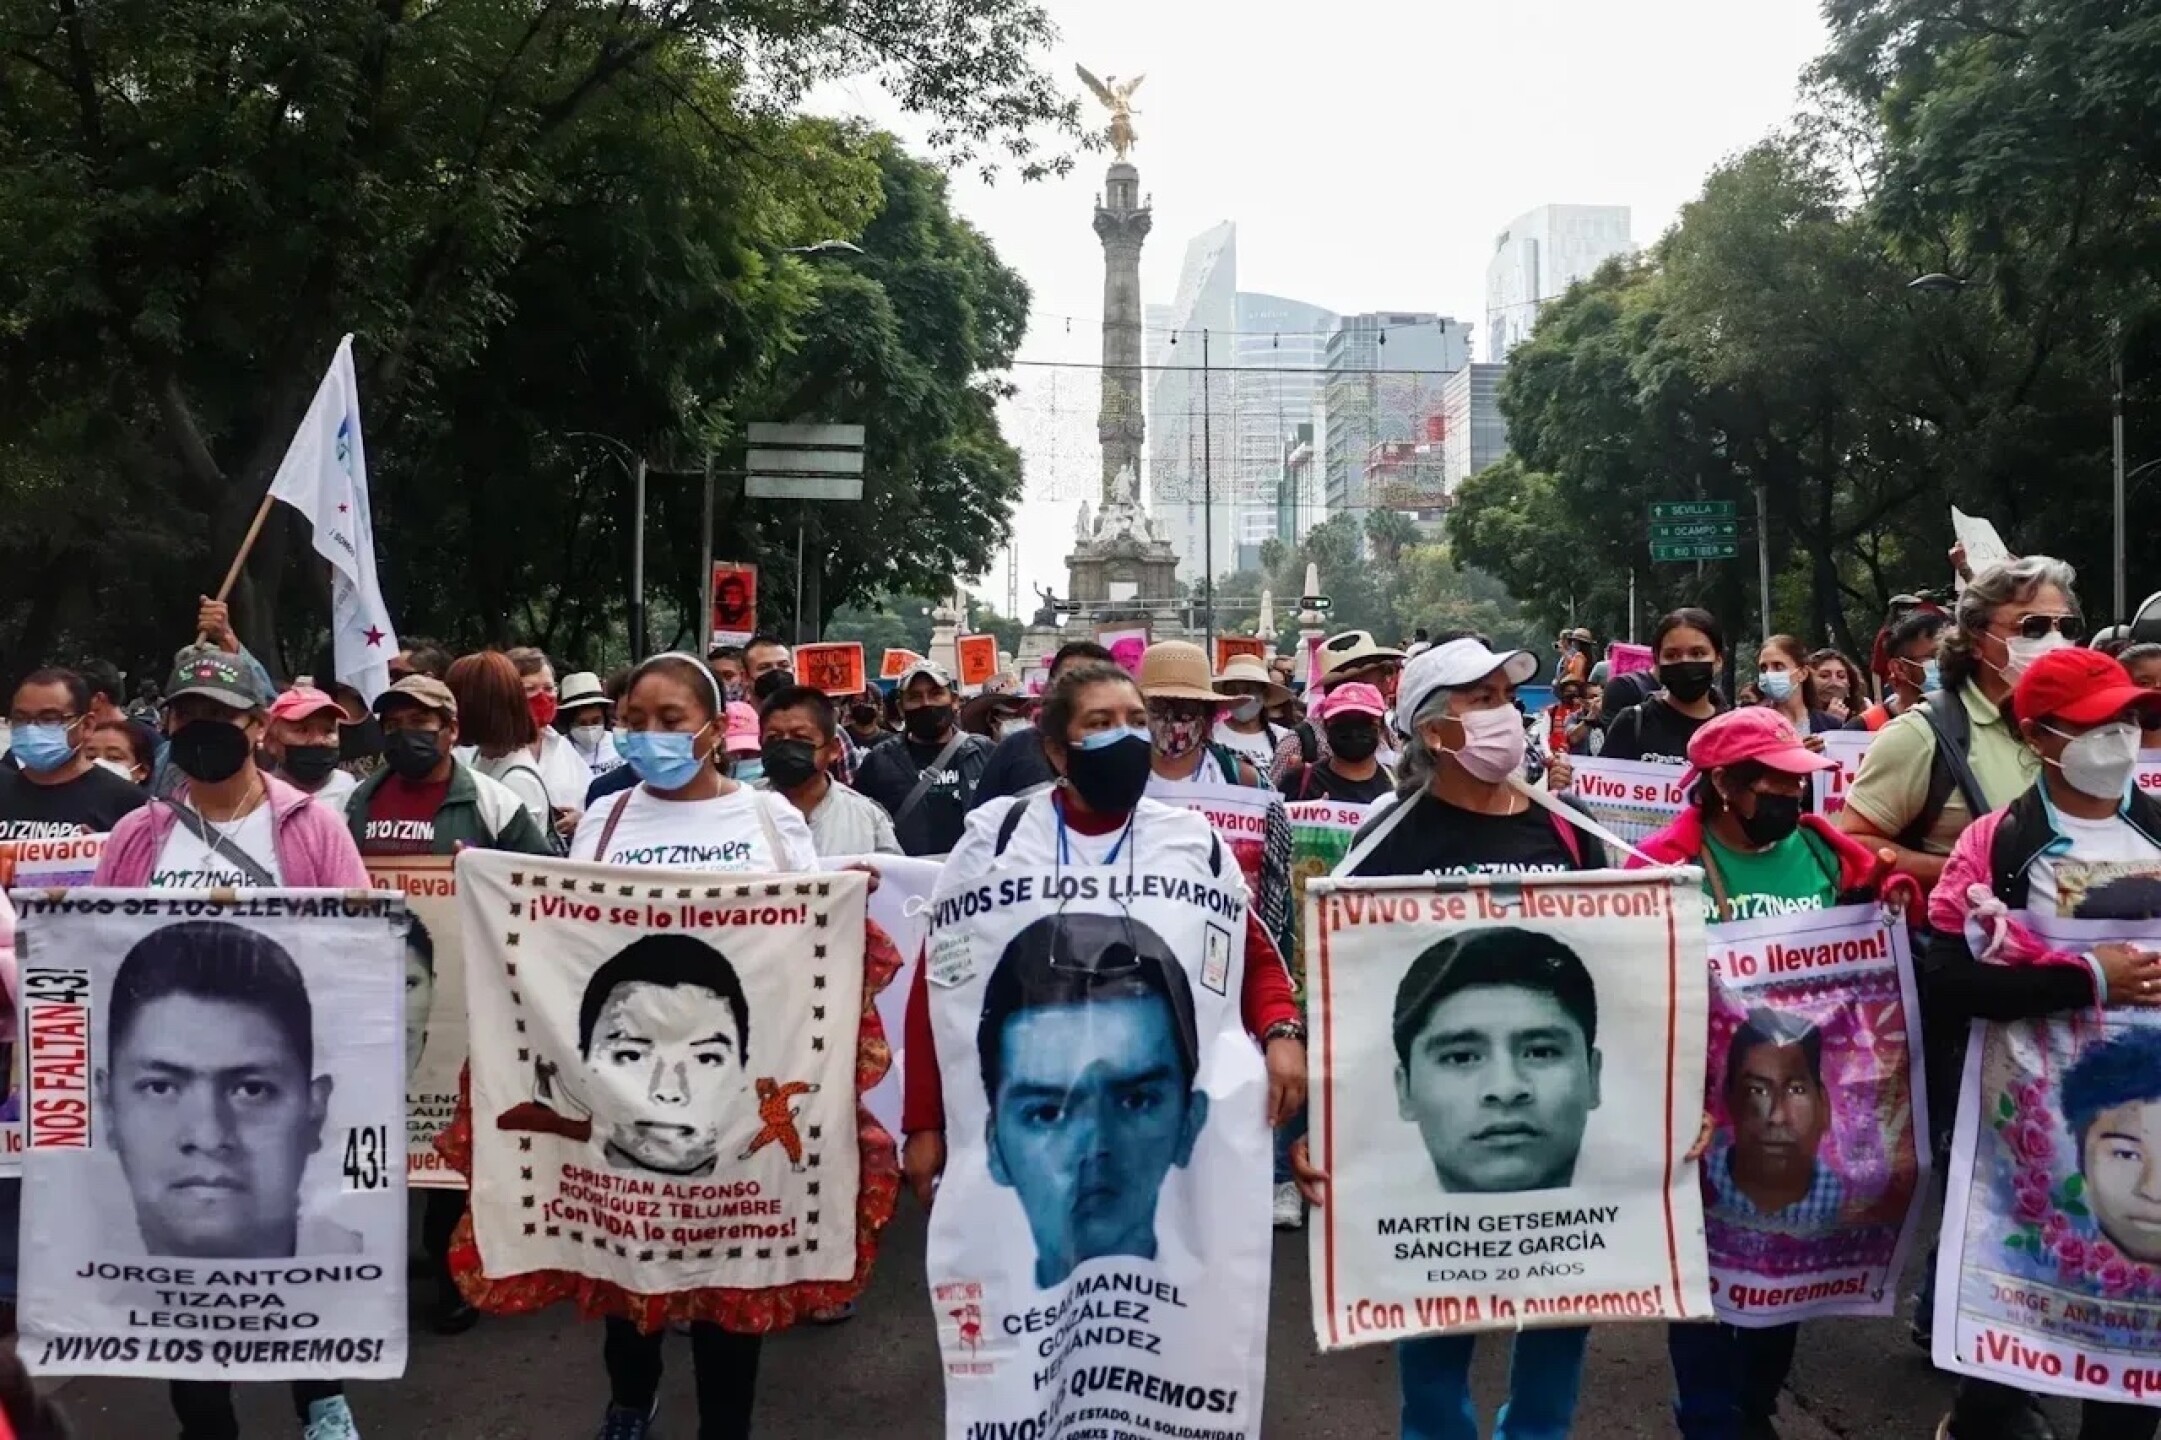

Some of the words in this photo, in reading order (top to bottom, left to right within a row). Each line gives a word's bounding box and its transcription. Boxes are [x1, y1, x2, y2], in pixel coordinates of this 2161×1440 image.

[1671, 505, 1712, 515] SEVILLA
[1674, 525, 1717, 536] OCAMPO
[1574, 774, 1627, 797] ¡Vivo
[1633, 785, 1657, 801] se
[1664, 783, 1683, 804] lo
[1338, 810, 1360, 825] se
[611, 841, 752, 865] AYOTZINAPA
[1000, 876, 1034, 906] SE
[1042, 875, 1099, 900] LOS
[529, 895, 601, 922] ¡Vivo
[608, 907, 640, 927] se
[646, 905, 672, 928] lo
[680, 905, 808, 928] llevaron!
[1331, 892, 1420, 932] ¡Vivo
[1430, 898, 1467, 921] se
[1519, 883, 1662, 918] llevaron!
[1727, 950, 1759, 978] lo
[1765, 929, 1888, 974] llevaron!
[24, 967, 90, 1004] 43!
[32, 1005, 86, 1091] FALTAN
[33, 1097, 87, 1148] NOS
[343, 1126, 389, 1190] 43!
[561, 1163, 655, 1196] CHRISTIAN
[661, 1180, 762, 1200] ALFONSO
[558, 1180, 661, 1218] RODRÍGUEZ
[668, 1199, 781, 1220] TELUMBRE
[542, 1198, 589, 1224] ¡Con
[591, 1206, 638, 1240] VIDA
[644, 1221, 666, 1242] lo
[671, 1216, 798, 1246] queremos!
[1377, 1213, 1471, 1236] MARTÍN
[1477, 1205, 1620, 1233] GETSEMANY
[1394, 1238, 1513, 1260] SÁNCHEZ
[1518, 1231, 1606, 1257] GARCÍA
[76, 1261, 196, 1285] JORGE
[205, 1264, 384, 1287] ANTONIO
[1426, 1268, 1488, 1284] EDAD
[1495, 1267, 1520, 1282] 20
[1525, 1261, 1586, 1279] AÑOS
[155, 1290, 286, 1309] TIZAPA
[1075, 1272, 1188, 1308] MANUEL
[1728, 1270, 1870, 1310] queremos!
[1989, 1283, 2051, 1314] JORGE
[128, 1310, 320, 1332] LEGIDEÑO
[1345, 1298, 1407, 1336] ¡Con
[1414, 1295, 1483, 1329] VIDA
[38, 1336, 141, 1366] ¡VIVOS
[146, 1338, 203, 1364] LOS
[211, 1338, 385, 1369] QUEREMOS!
[1975, 1328, 2063, 1377] ¡Vivo
[2074, 1352, 2110, 1386] lo
[1069, 1365, 1238, 1414] QUEREMOS!
[1078, 1407, 1132, 1426] ESTADO,
[1135, 1414, 1151, 1429] LA
